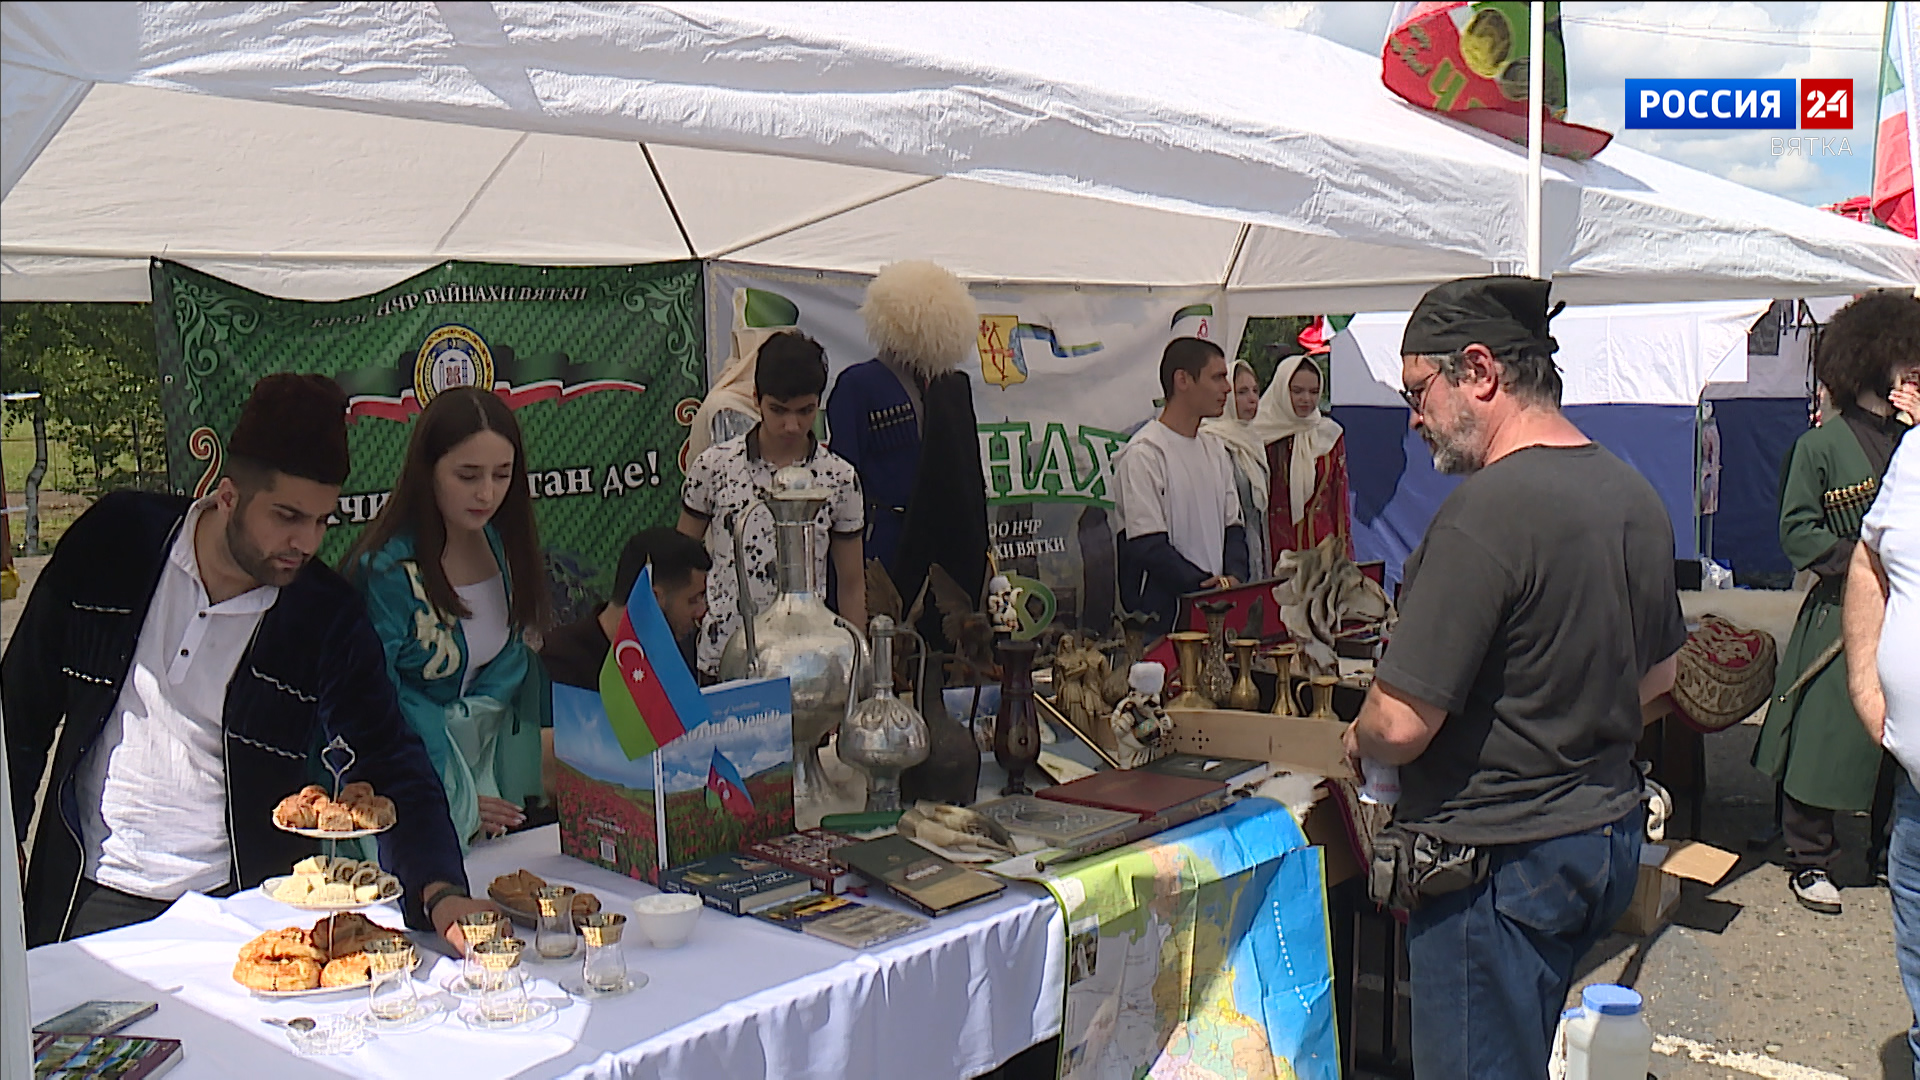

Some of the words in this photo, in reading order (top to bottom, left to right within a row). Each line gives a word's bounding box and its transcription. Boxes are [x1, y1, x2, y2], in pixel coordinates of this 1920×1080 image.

[424, 283, 514, 305] ВАЙНАХИ
[518, 286, 588, 302] ВЯТКИ
[602, 450, 661, 499] де!
[977, 428, 1128, 503] НАХ
[1012, 519, 1043, 536] НЧР
[994, 543, 1015, 560] ХИ
[1015, 537, 1066, 557] ВЯТКИ
